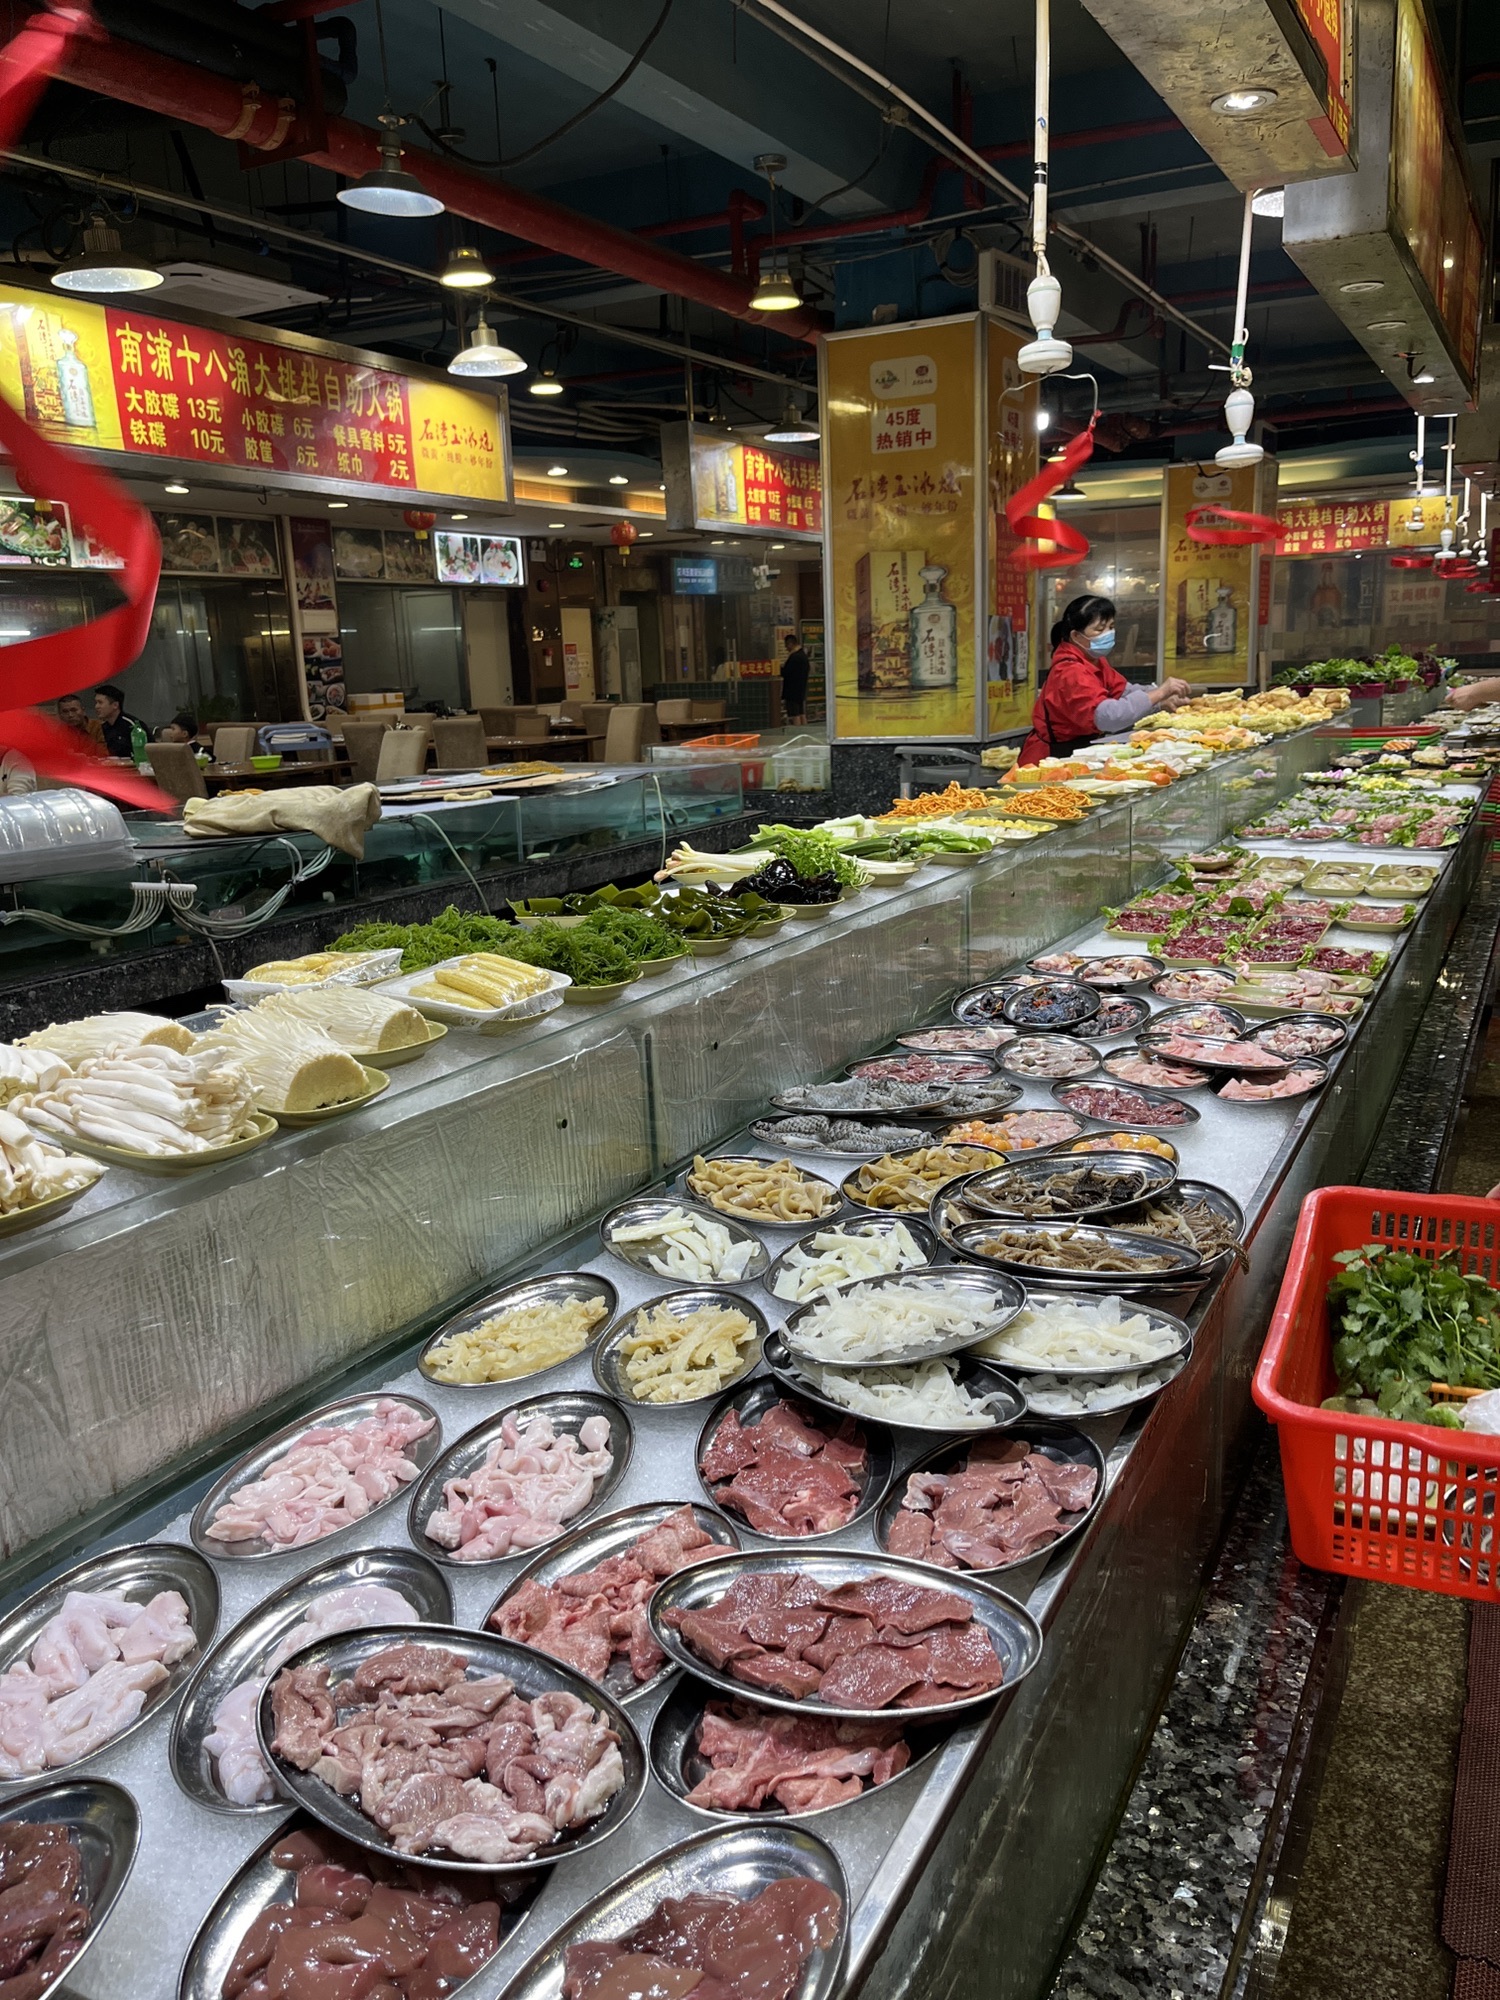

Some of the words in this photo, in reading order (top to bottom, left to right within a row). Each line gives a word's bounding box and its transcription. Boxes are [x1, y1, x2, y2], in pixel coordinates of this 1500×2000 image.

[116, 322, 404, 425] 南浦十八涌大排档自助火锅
[125, 386, 180, 419] 大胶碟
[187, 397, 222, 424] 13元
[242, 408, 285, 437] 小胶碟
[293, 417, 316, 440] 6元
[333, 424, 385, 453] 餐具酱料
[387, 433, 408, 455] 5元
[876, 428, 932, 450] 热销中
[886, 408, 921, 427] 45度
[130, 418, 167, 448] 铁碟
[191, 428, 225, 454] 10元
[244, 437, 274, 463] 胶筐
[297, 446, 319, 468] 6元
[337, 452, 363, 476] 纸巾
[390, 460, 410, 481] 2元
[1277, 504, 1385, 529] 涌大排档自助火锅
